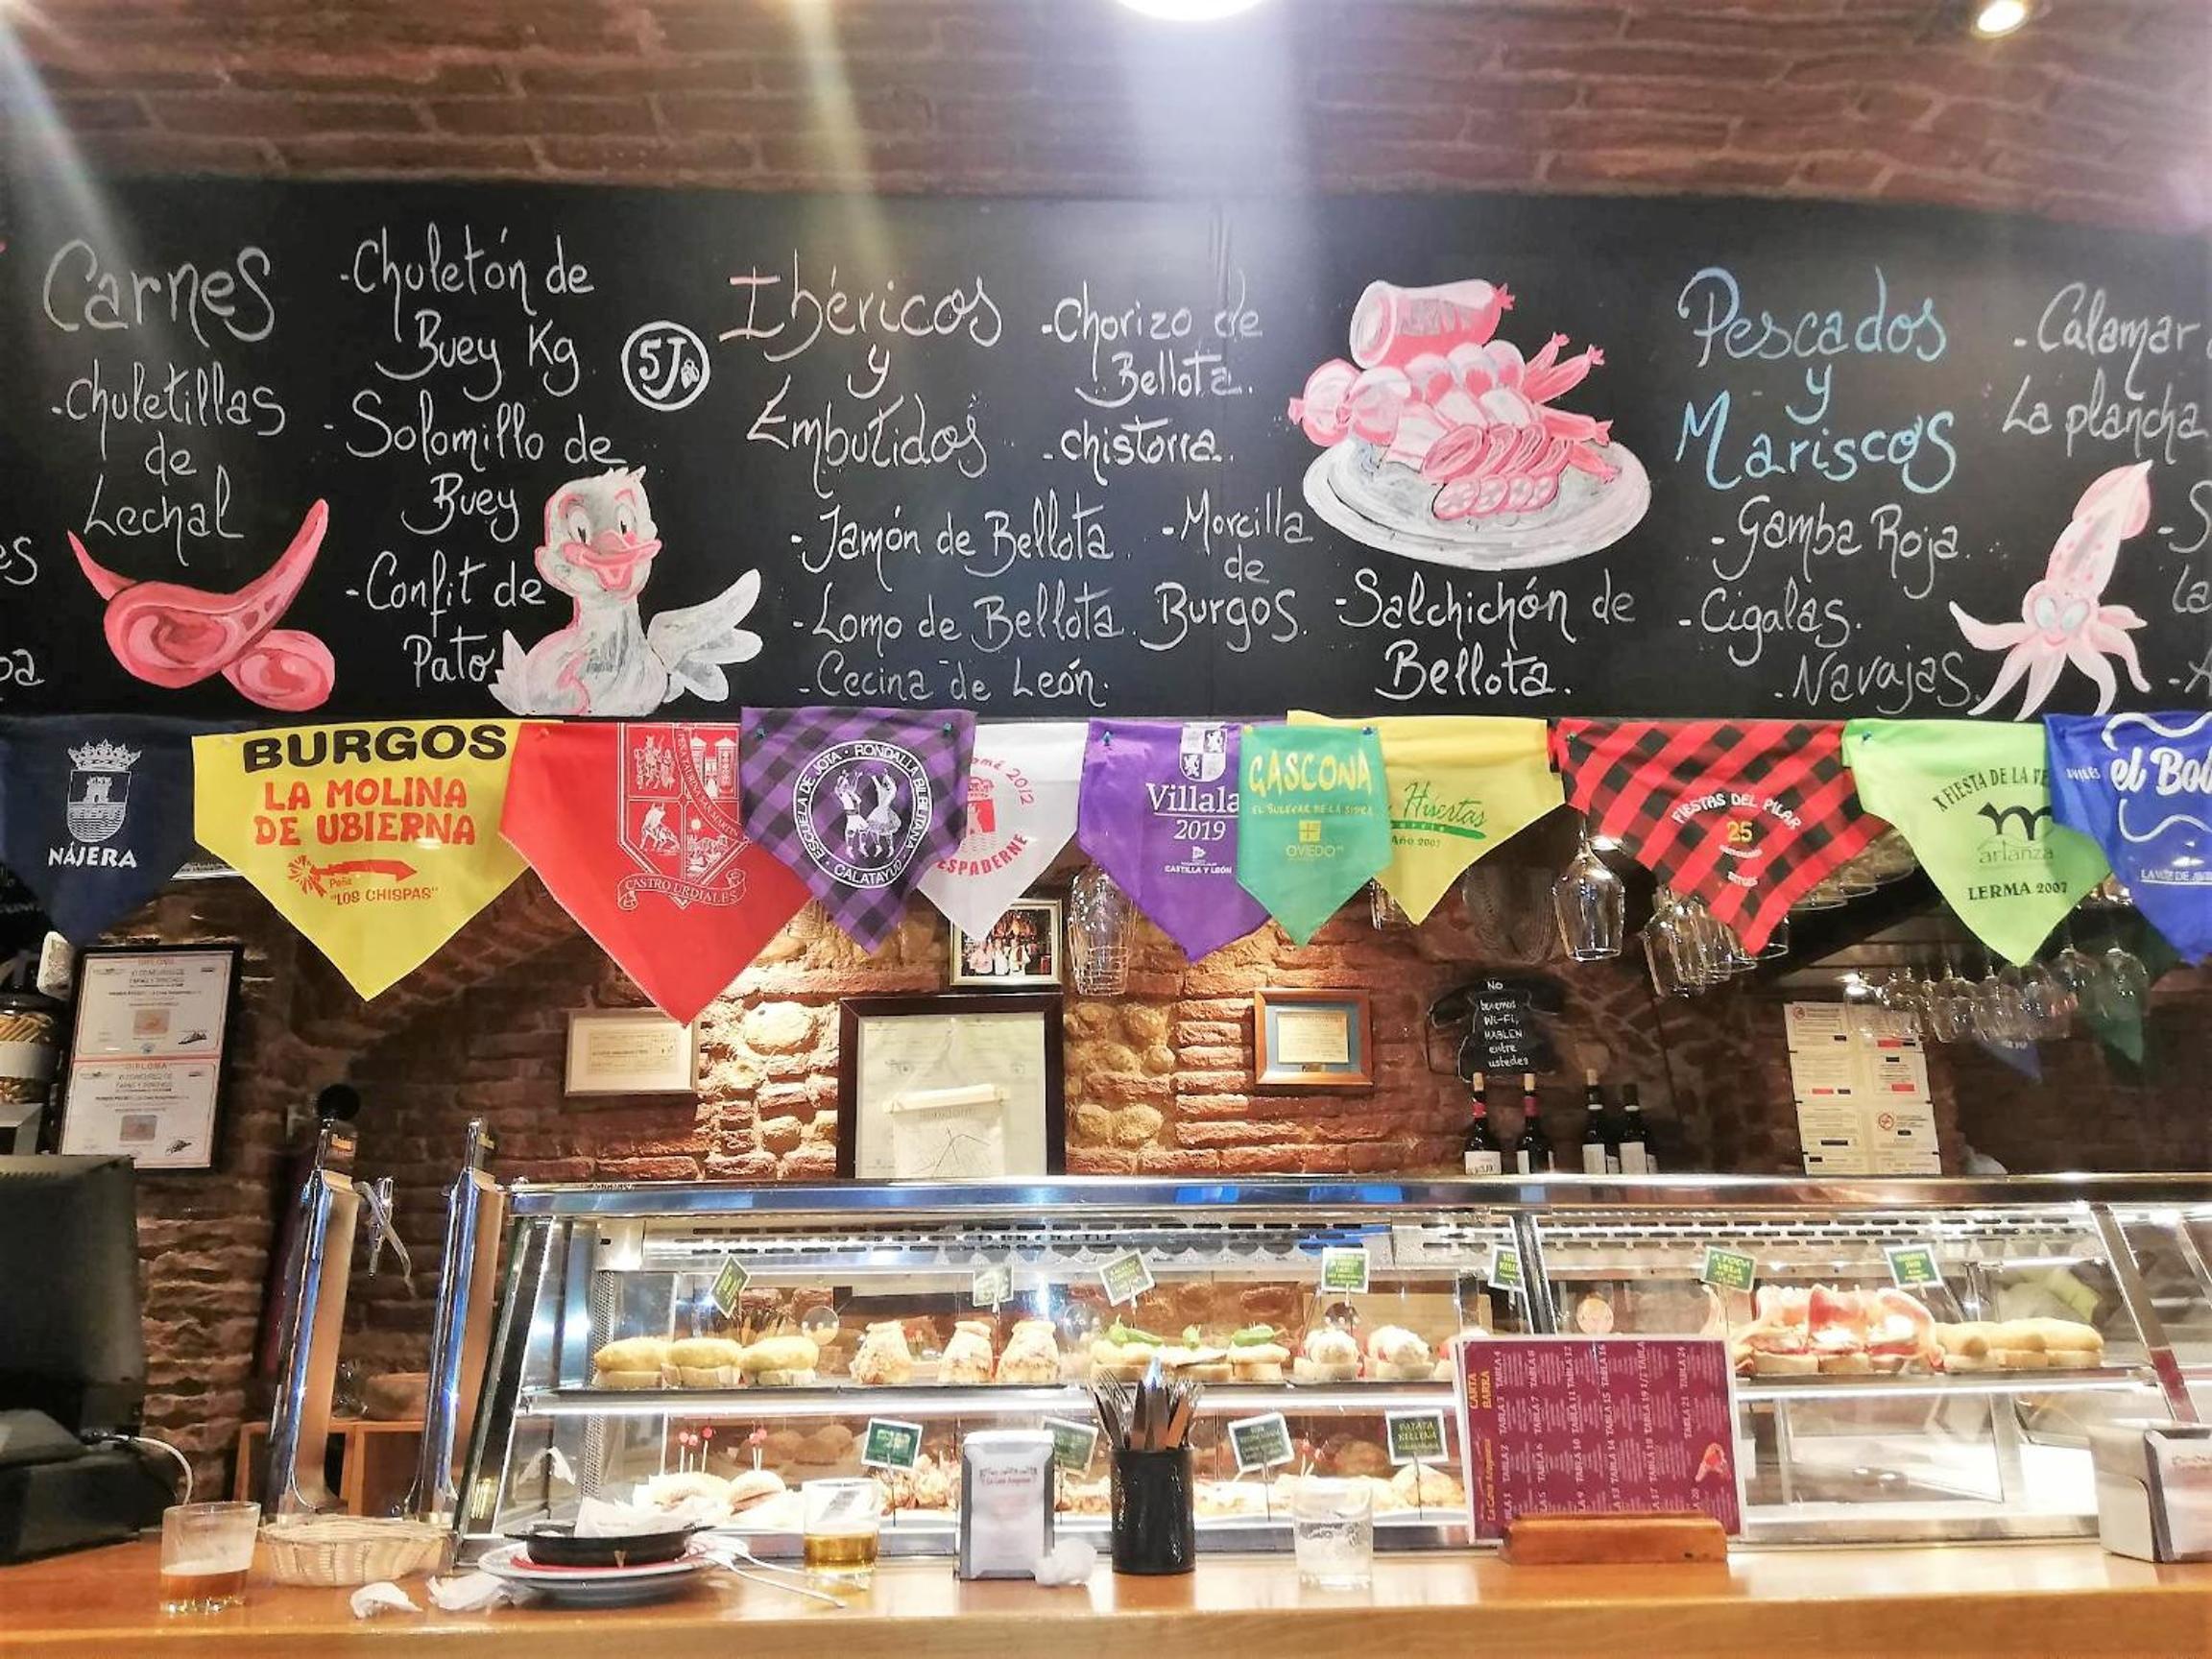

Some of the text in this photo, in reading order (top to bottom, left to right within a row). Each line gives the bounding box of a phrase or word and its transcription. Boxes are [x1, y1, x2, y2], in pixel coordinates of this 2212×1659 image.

[545, 233, 594, 295] de
[44, 240, 275, 347] Carnes
[719, 249, 1002, 362] Ibéricos
[1214, 267, 1262, 342] de
[1678, 265, 1947, 368] Pescados
[375, 309, 502, 401] Buey
[847, 344, 891, 398] y
[1786, 364, 1832, 425] y
[2002, 367, 2210, 467] La plancha
[145, 432, 197, 485] de
[565, 414, 626, 464] de
[747, 374, 989, 497] Embutidos
[1675, 390, 1957, 493] Mariscos
[84, 465, 244, 566] Lechal
[401, 473, 519, 543] Buey
[936, 507, 976, 555] de
[493, 562, 546, 608] de
[1225, 551, 1269, 584] de
[918, 594, 962, 642] de
[1593, 568, 1636, 623] de
[404, 626, 495, 688] Pato
[950, 662, 991, 702] de
[243, 724, 507, 773] BURGOS
[854, 744, 921, 778] RONDALLA
[2110, 746, 2147, 793] el
[265, 777, 467, 810] LA MOLINA
[1006, 768, 1035, 805] 2012
[1248, 748, 1373, 797] GASCONA
[1933, 796, 1948, 812] X
[1942, 771, 1987, 805] FIESTA
[1989, 768, 2007, 785] DE
[2012, 767, 2028, 783] LA
[253, 811, 475, 846] DE UBIERNA
[797, 753, 842, 860] ESCUELA DE JOTA
[1671, 793, 1802, 830] FIESTAS DEL PILAR
[1173, 820, 1226, 840] 2019
[1286, 845, 1335, 857] OVIEDO
[1727, 821, 1752, 842] 25
[1979, 840, 2054, 863] arlanza
[48, 842, 137, 868] NÁJERA
[833, 859, 902, 885] CALATAYUD
[1165, 865, 1201, 874] CASTILLA
[625, 878, 739, 904] CASTRO URDIALES
[1968, 881, 2067, 901] LERMA 2007
[1480, 999, 1516, 1011] tenemos
[1488, 1054, 1528, 1068] ustedes
[1489, 1042, 1517, 1053] entre
[1467, 1373, 1479, 1408] CARTA
[1481, 1370, 1492, 1409] BARRA
